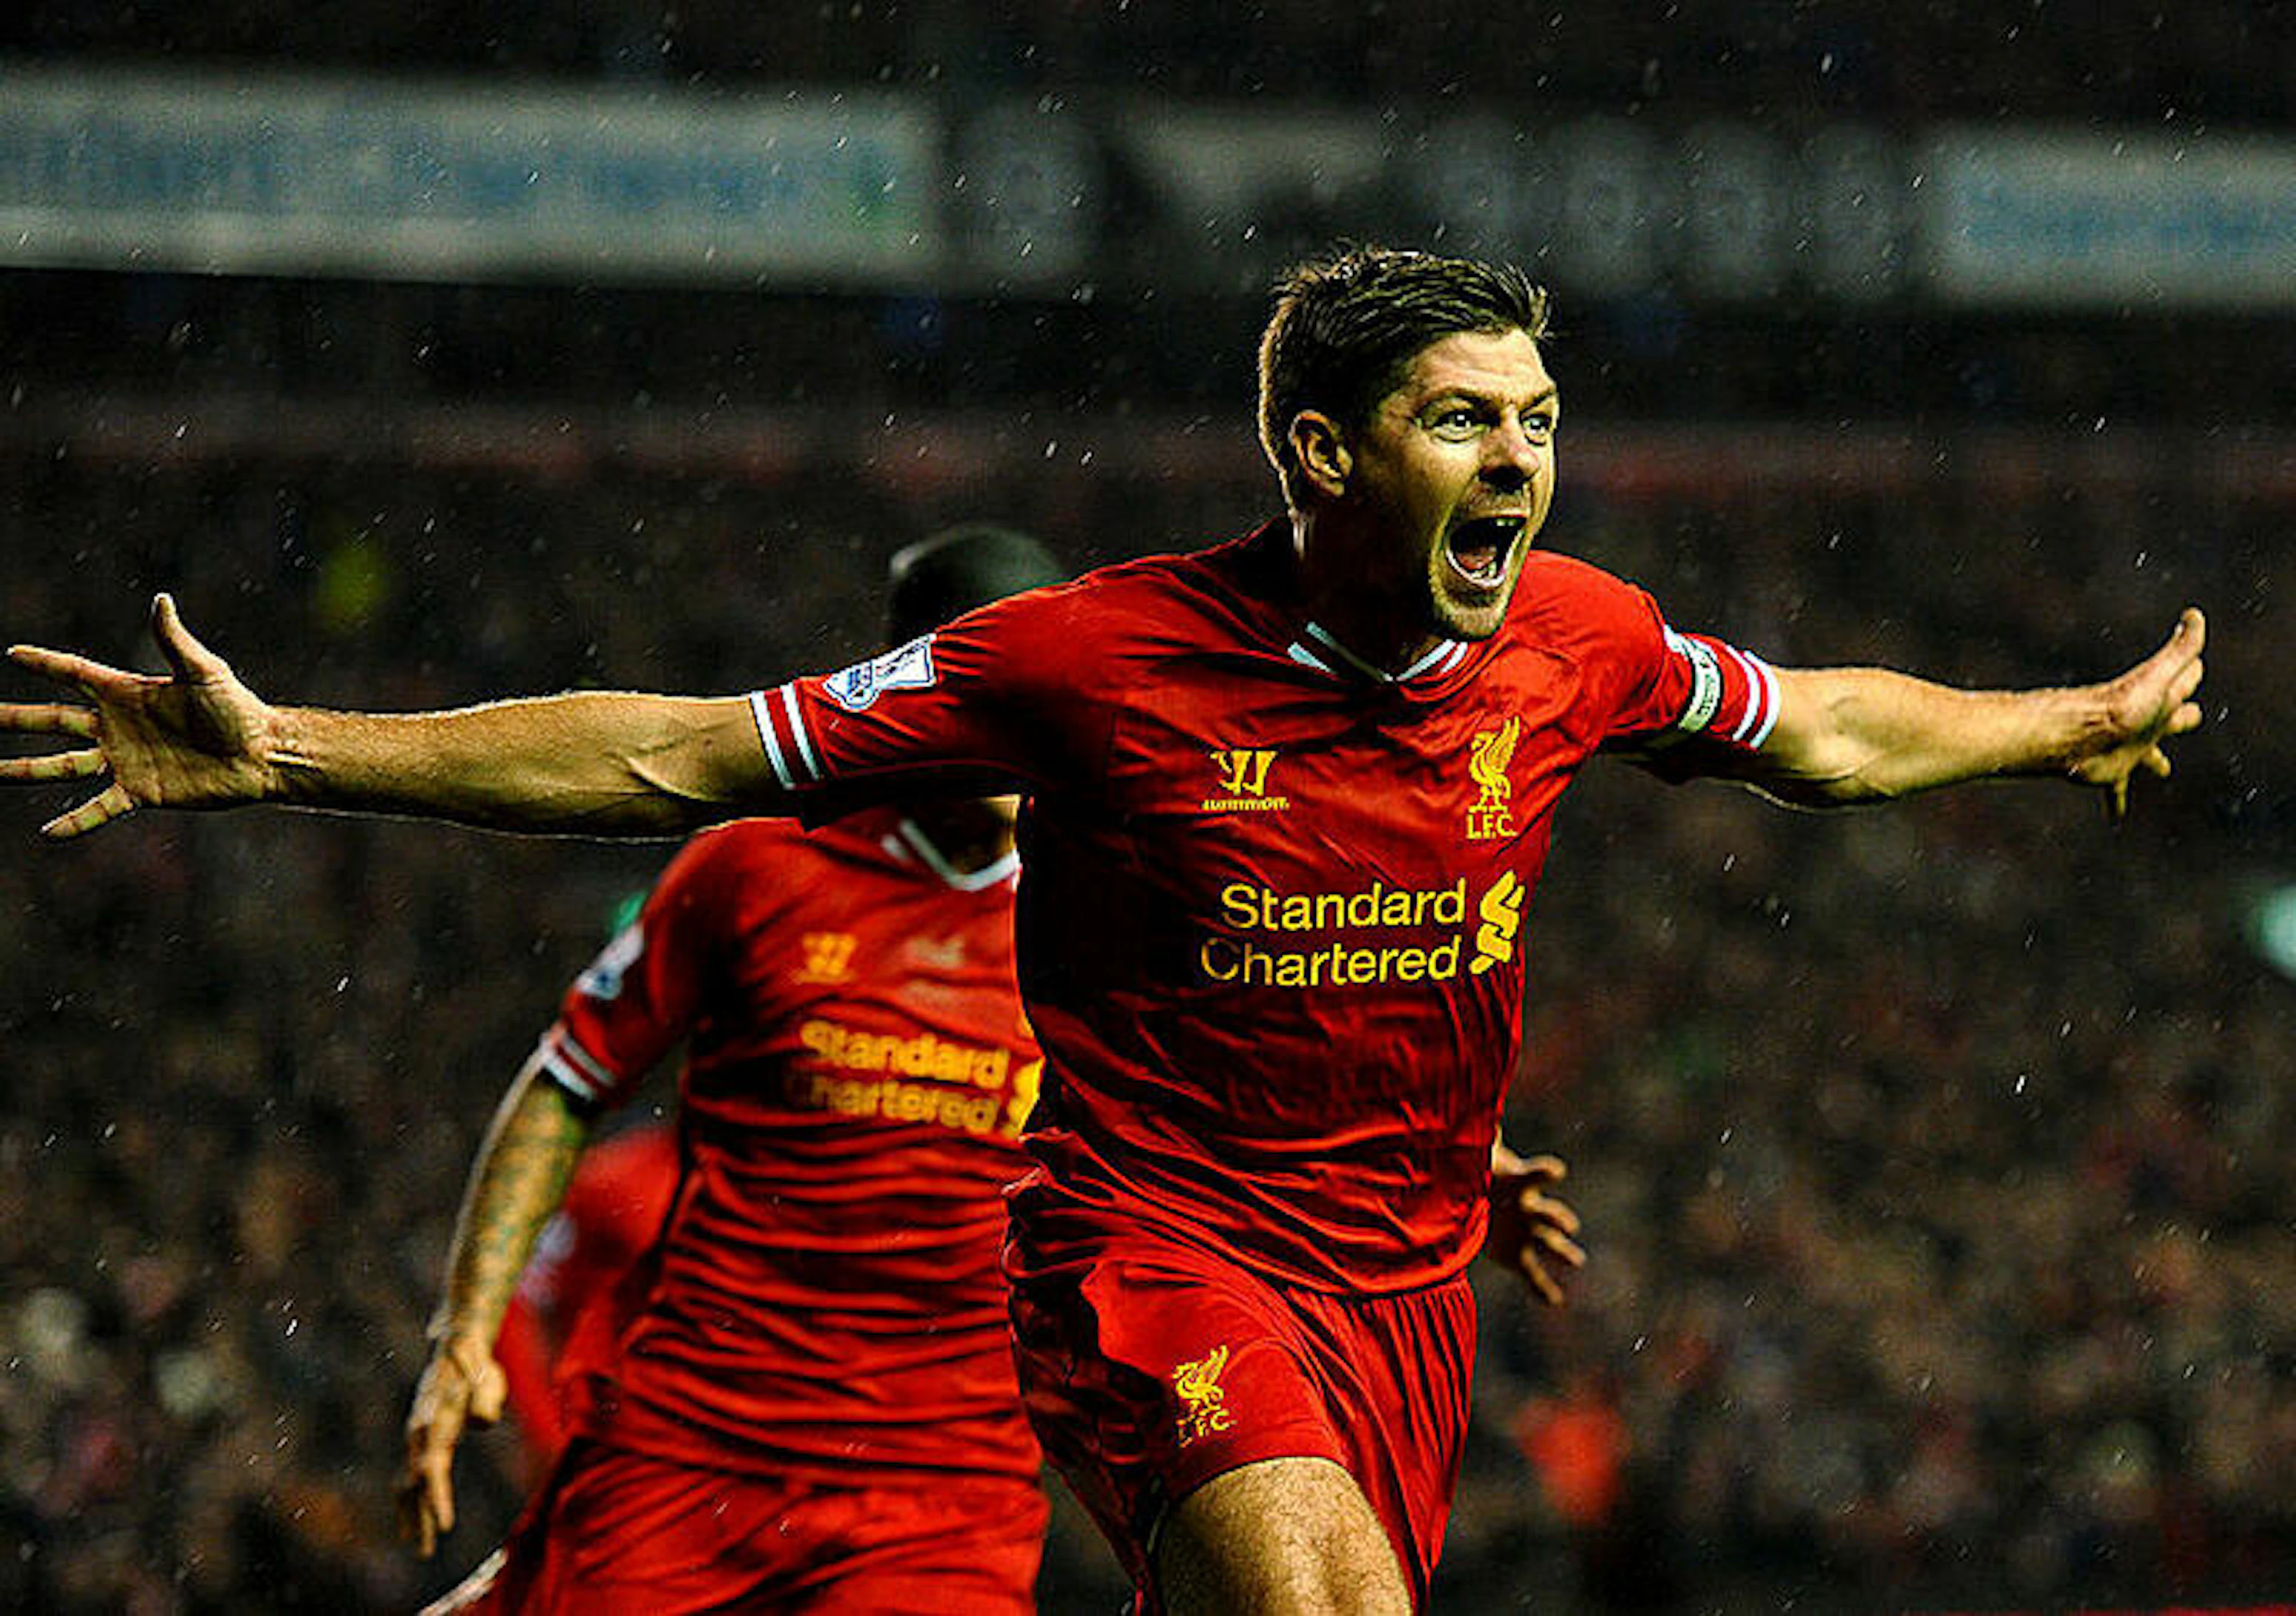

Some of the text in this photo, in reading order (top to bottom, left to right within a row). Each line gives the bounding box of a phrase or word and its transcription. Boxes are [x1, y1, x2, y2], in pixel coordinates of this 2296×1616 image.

[1221, 877, 1465, 931] Standard
[1201, 934, 1463, 986] Chartered
[800, 1020, 1010, 1088] Standard
